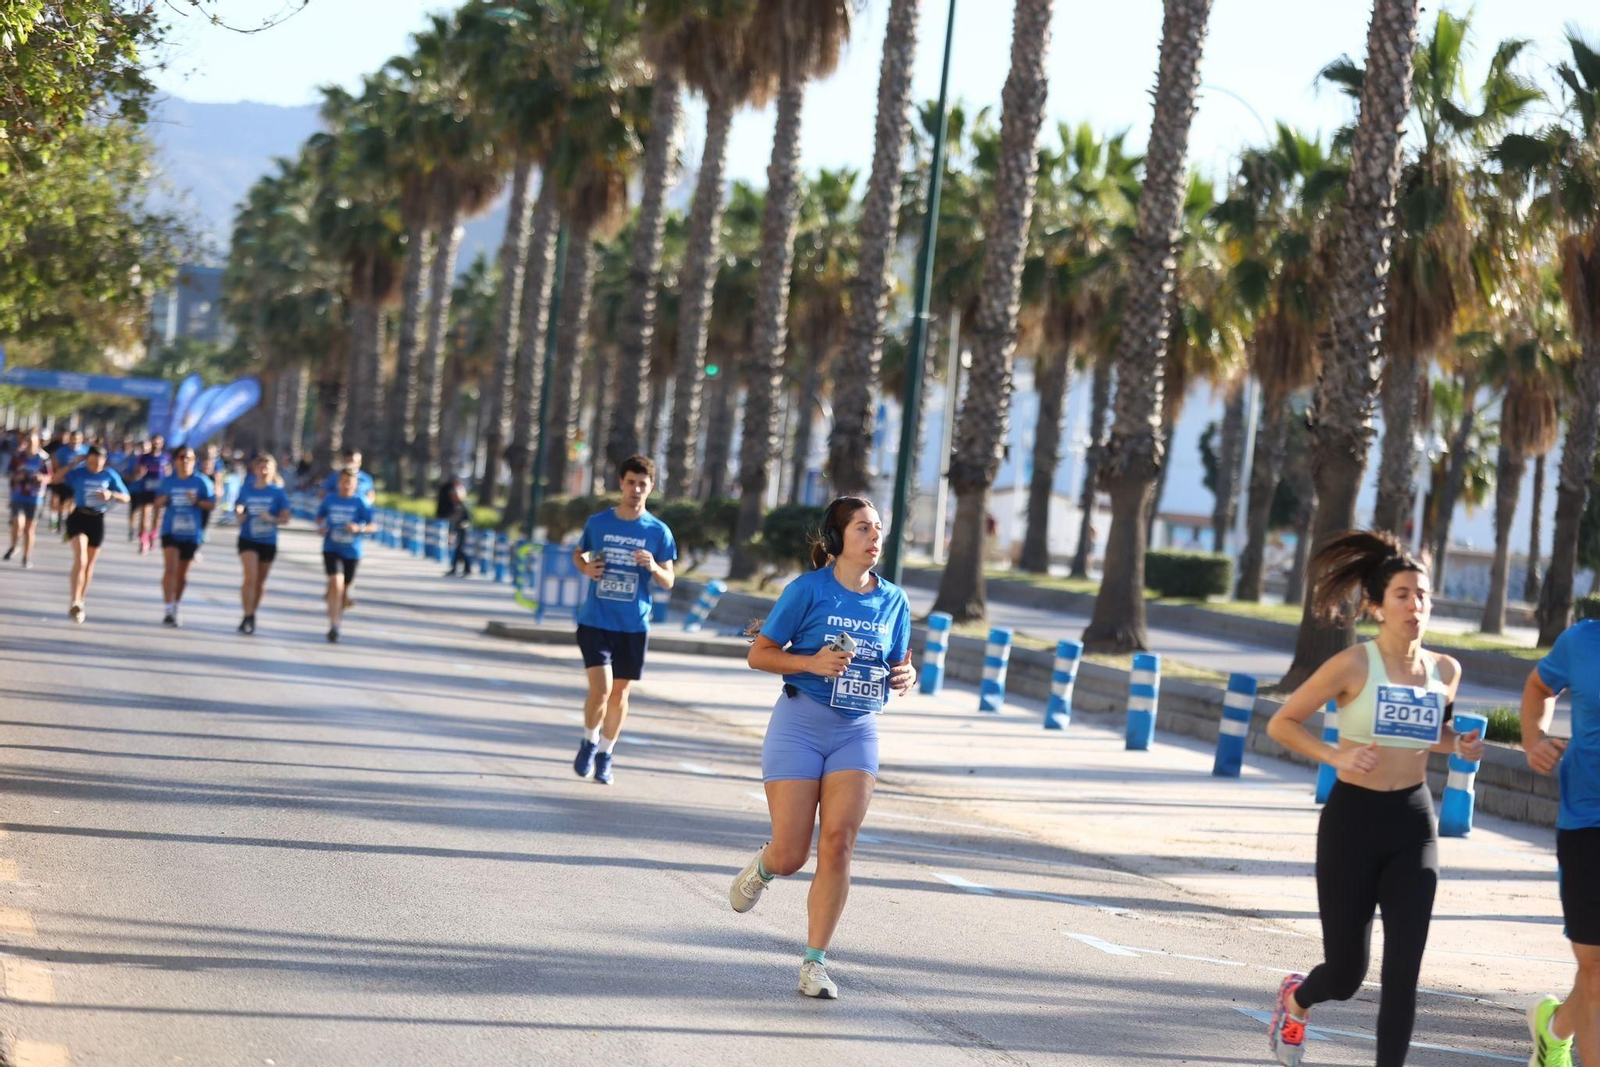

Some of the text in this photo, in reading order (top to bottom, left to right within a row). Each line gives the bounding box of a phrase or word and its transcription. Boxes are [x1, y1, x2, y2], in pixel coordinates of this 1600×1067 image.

[603, 534, 646, 548] mayoral
[602, 581, 632, 592] 2016
[827, 615, 889, 635] mayoral
[842, 680, 879, 697] 1505
[1384, 704, 1434, 724] 2014
